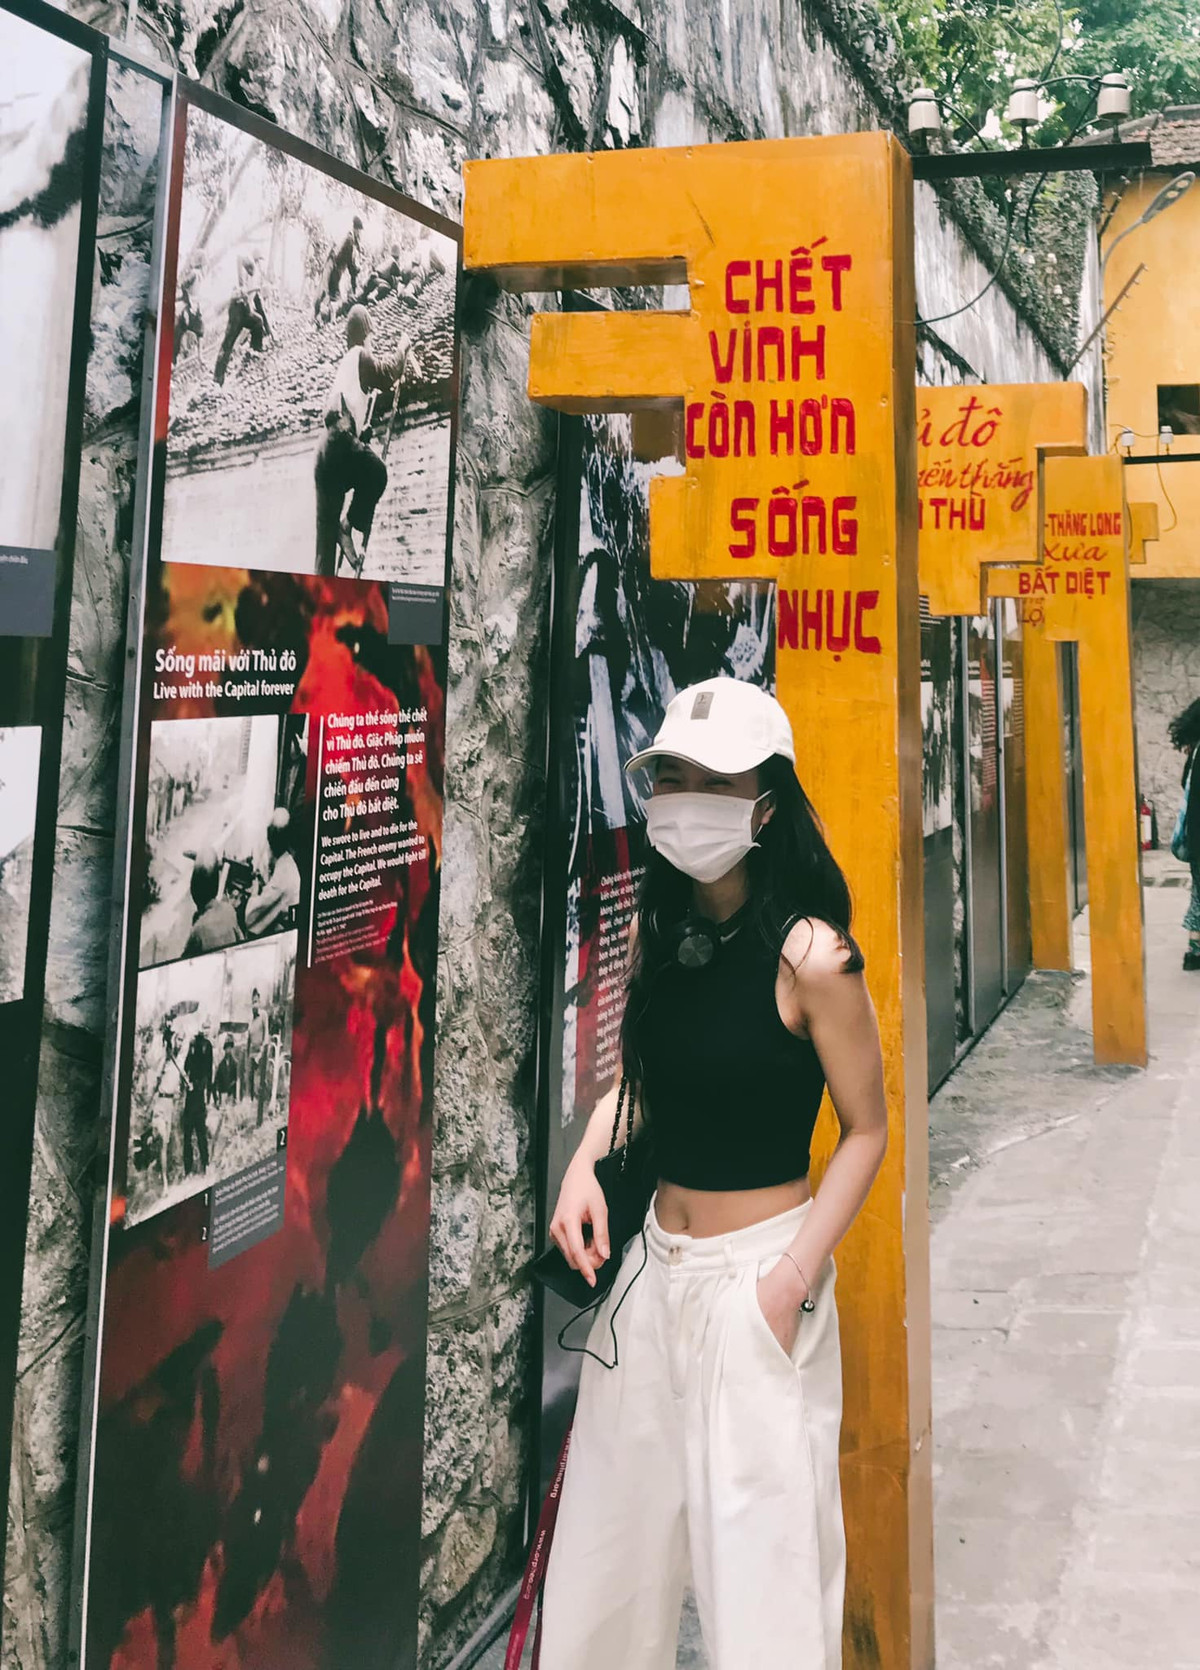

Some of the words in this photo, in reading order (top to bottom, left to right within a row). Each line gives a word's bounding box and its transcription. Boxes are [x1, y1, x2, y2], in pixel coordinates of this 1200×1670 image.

[725, 236, 852, 315] CHẾT
[708, 320, 826, 384] VINH
[685, 390, 756, 459] CÒN
[770, 393, 856, 456] HƠN
[940, 396, 1003, 447] đô
[728, 479, 859, 559] SỐNG
[929, 491, 986, 531] THÙ
[1090, 512, 1121, 536] LONG
[1019, 565, 1060, 595] BẤT
[1066, 567, 1111, 599] DIỆT
[778, 589, 882, 662] NHỤC
[155, 645, 195, 678] Sống
[198, 649, 226, 672] mãi
[228, 649, 250, 672] với
[252, 648, 277, 671] Thủ
[280, 649, 297, 671] đô
[153, 682, 177, 699] Live
[179, 681, 203, 699] with
[205, 680, 223, 697] the
[224, 680, 260, 701] Capital
[261, 679, 295, 695] forever
[327, 713, 355, 731] Chúng
[356, 714, 364, 727] ta
[380, 708, 398, 727] sống
[412, 706, 428, 722] chết
[335, 734, 352, 751] Thủ
[366, 733, 383, 750] Giặc
[384, 731, 403, 748] Pháp
[404, 727, 425, 743] muốn
[325, 757, 351, 775] chiếm
[351, 755, 367, 771] Thủ
[381, 753, 405, 769] Chúng
[406, 752, 414, 765] ta
[324, 779, 347, 798] chiến
[348, 777, 364, 794] đấu
[365, 775, 380, 792] đến
[381, 775, 400, 792] cùng
[322, 805, 339, 821] cho
[339, 802, 355, 818] Thủ
[356, 799, 367, 816] đô
[368, 796, 382, 814] bất
[321, 836, 332, 848] We
[332, 834, 351, 846] swore
[351, 832, 359, 842] to
[359, 829, 370, 840] live
[370, 825, 382, 838] and
[382, 826, 389, 836] to
[390, 823, 399, 834] die
[399, 821, 407, 832] for
[408, 819, 418, 831] the
[345, 848, 357, 860] The
[357, 843, 378, 858] French
[397, 834, 419, 848] wanted
[418, 835, 425, 845] to
[319, 870, 342, 883] occupy
[342, 866, 354, 877] the
[377, 858, 386, 870] We
[386, 853, 404, 867] would
[318, 886, 337, 901] death
[338, 884, 347, 896] for
[347, 881, 359, 894] the
